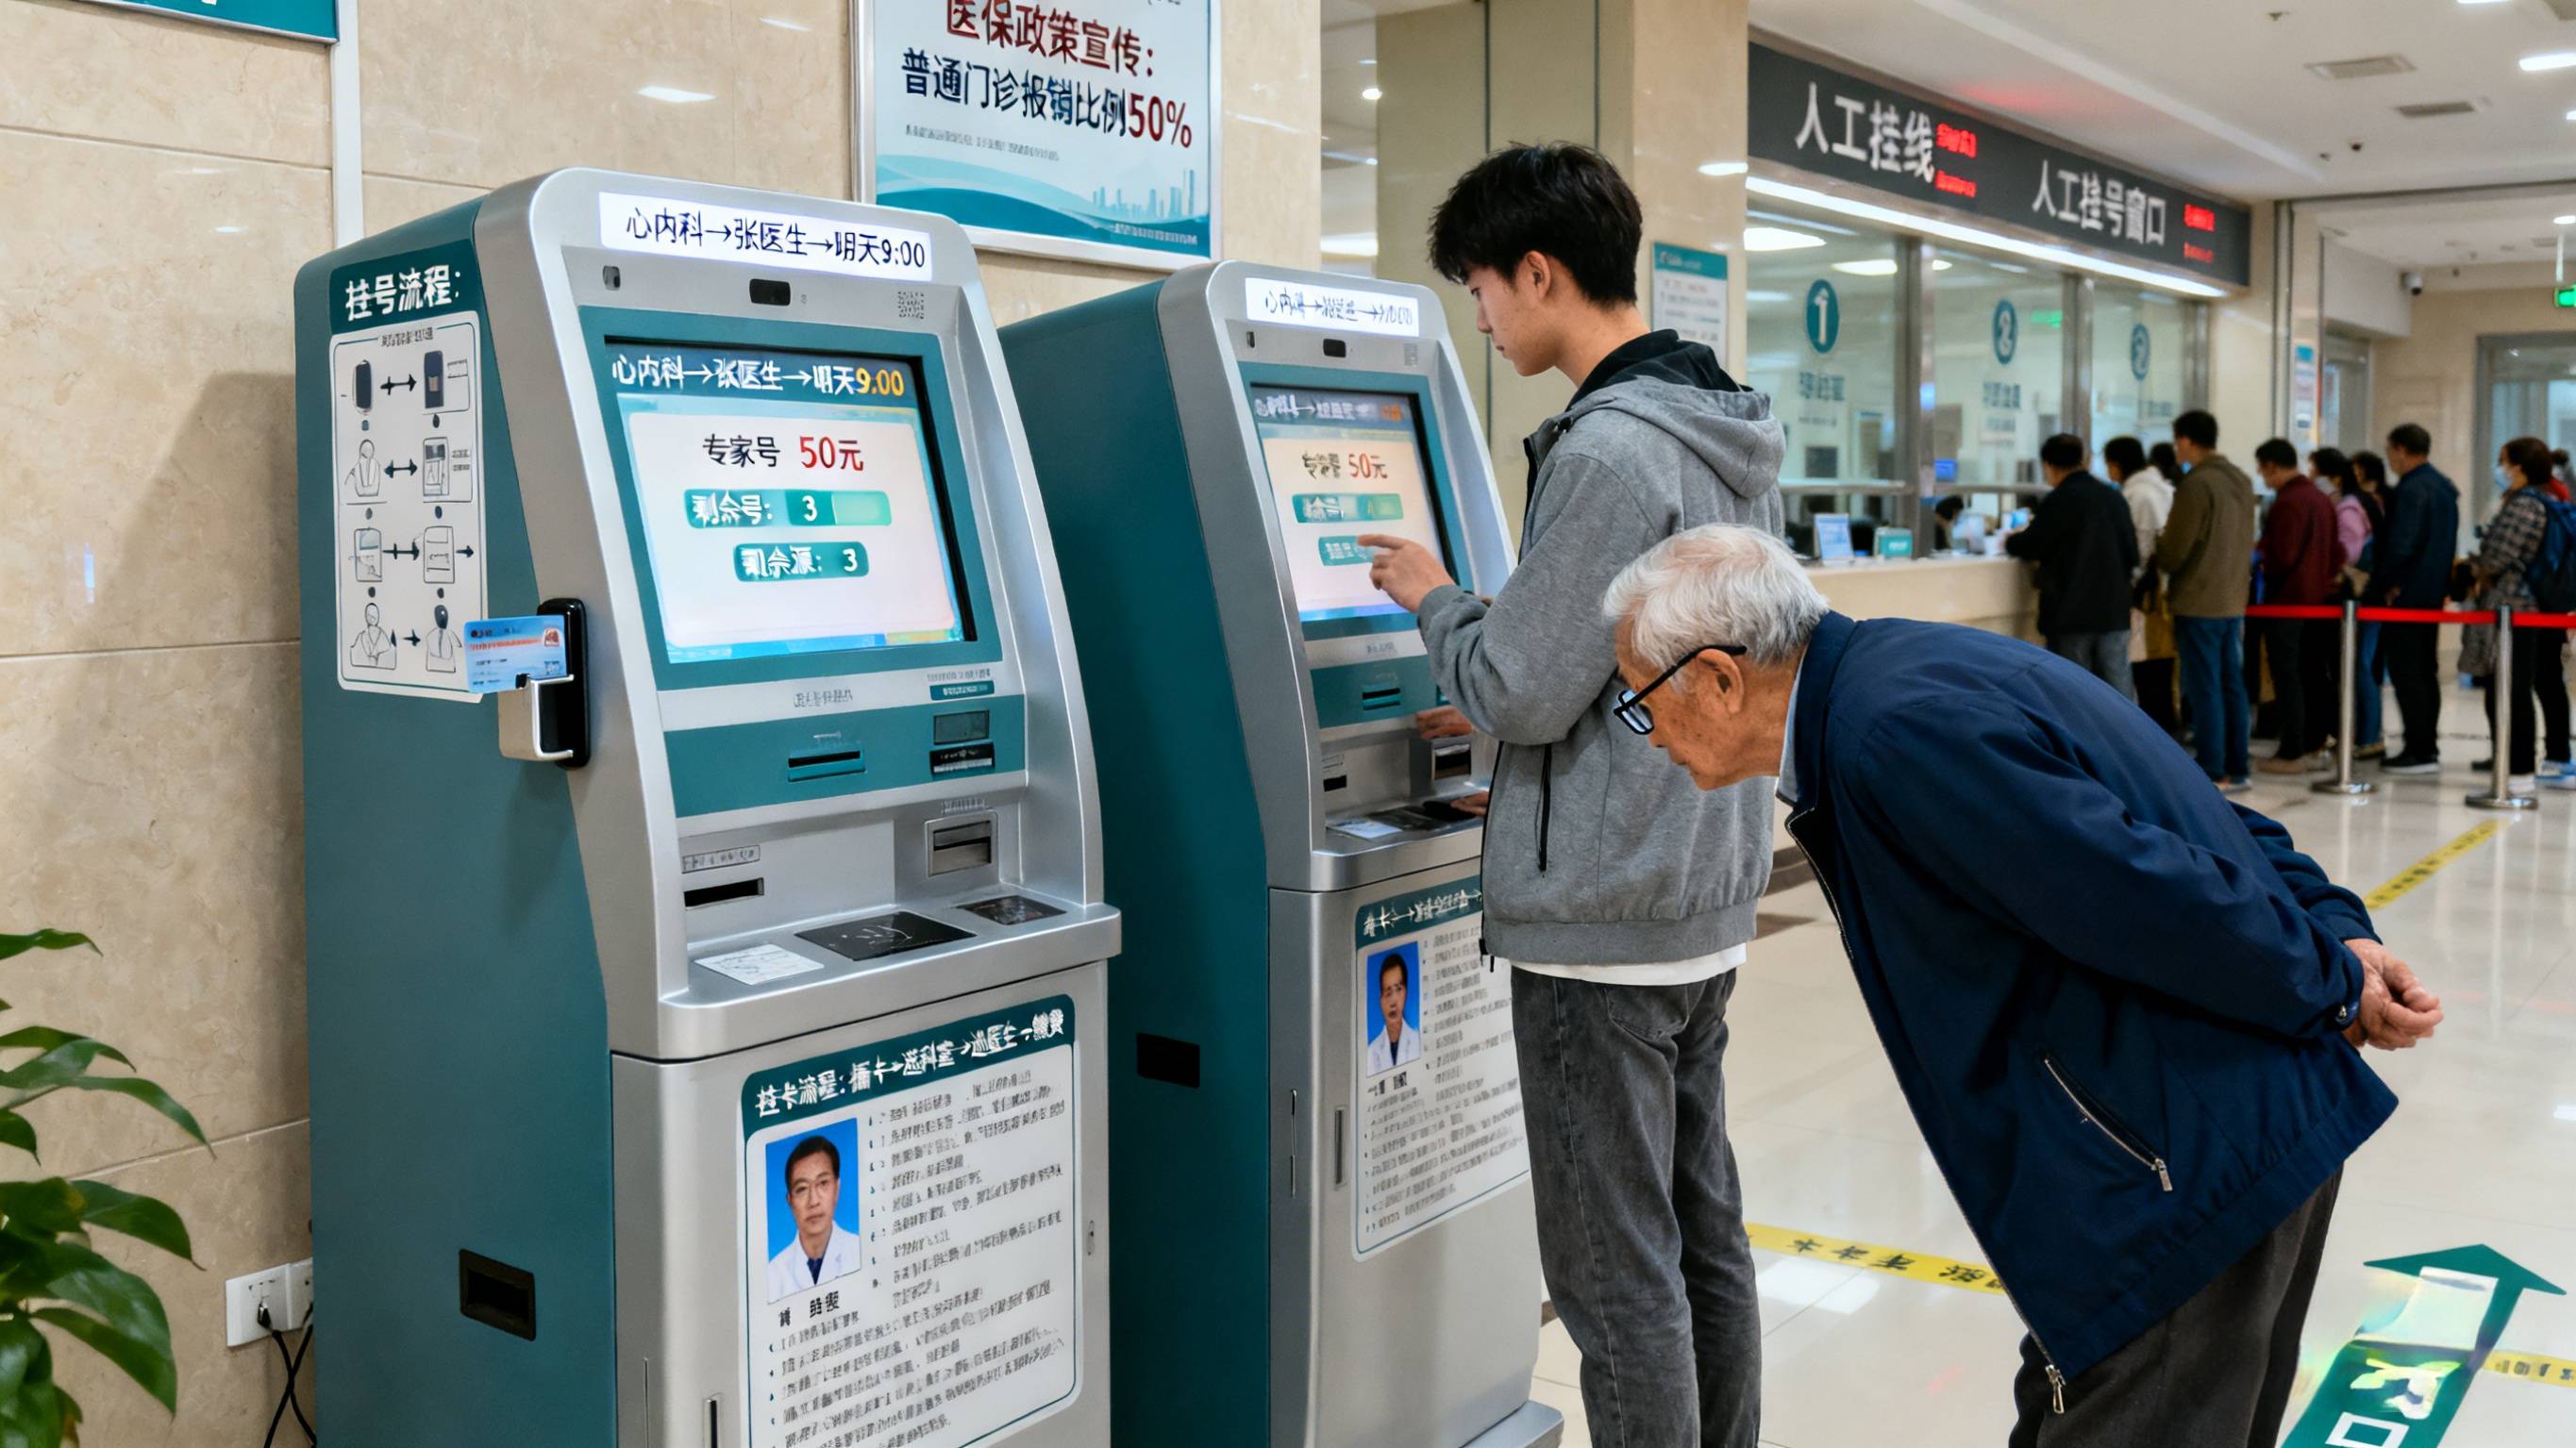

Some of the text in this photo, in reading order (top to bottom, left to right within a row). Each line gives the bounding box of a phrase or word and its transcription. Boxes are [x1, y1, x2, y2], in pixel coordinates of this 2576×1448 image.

[946, 0, 1153, 77] 医保政策宣传：
[2032, 158, 2166, 246] 人工挂号窗口
[627, 207, 925, 268] 心内科 张医生 明天9:00
[612, 354, 684, 391] 心内科
[703, 433, 864, 472] 专家号 50元
[1348, 453, 1388, 479] 50元
[801, 495, 818, 522] 3
[842, 548, 858, 572] 3
